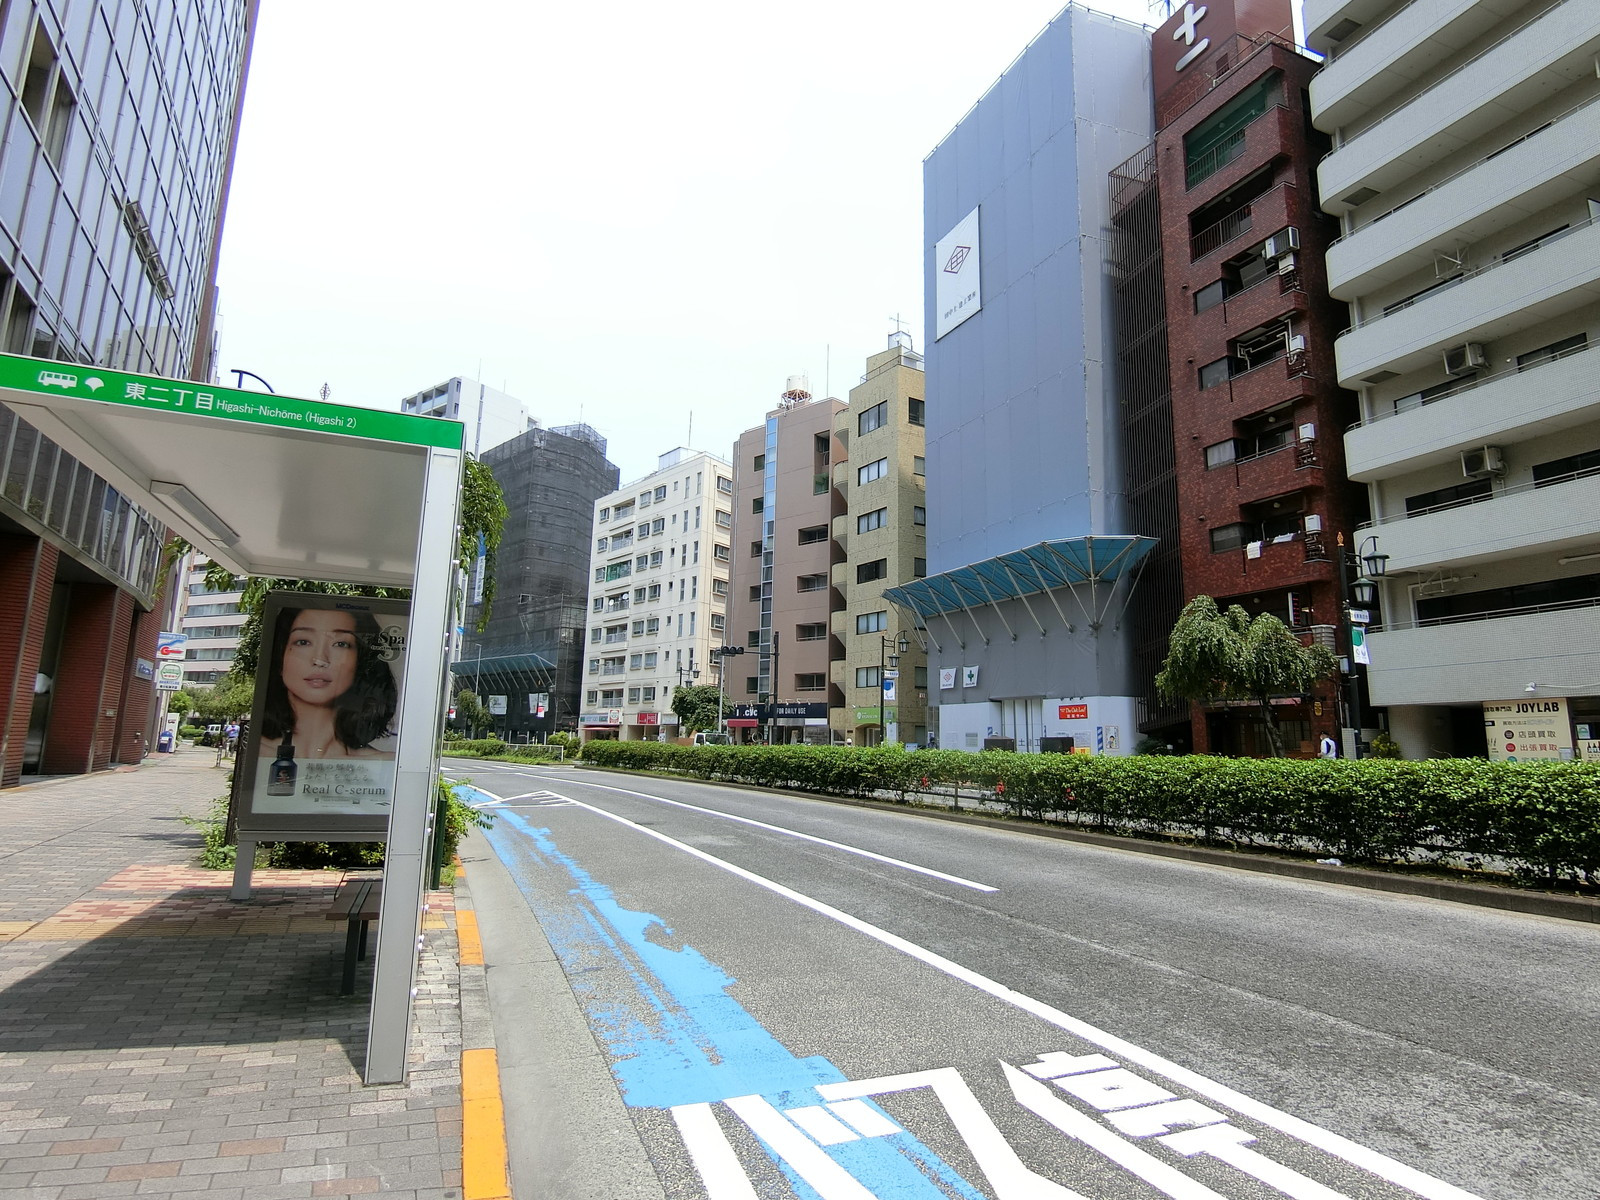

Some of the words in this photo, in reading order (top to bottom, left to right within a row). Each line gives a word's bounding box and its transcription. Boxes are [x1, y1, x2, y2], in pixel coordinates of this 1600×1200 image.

[124, 382, 214, 411] 東二丁目
[216, 399, 302, 421] Higashi-Nichōme
[305, 411, 344, 427] (Higashi
[346, 417, 357, 429] 2)
[378, 631, 406, 647] Spa
[1516, 702, 1559, 713] JOYLAB
[1518, 730, 1556, 739] 店頭買取
[1520, 743, 1558, 752] 出張買取
[302, 783, 330, 794] Real
[334, 784, 386, 795] C-serum
